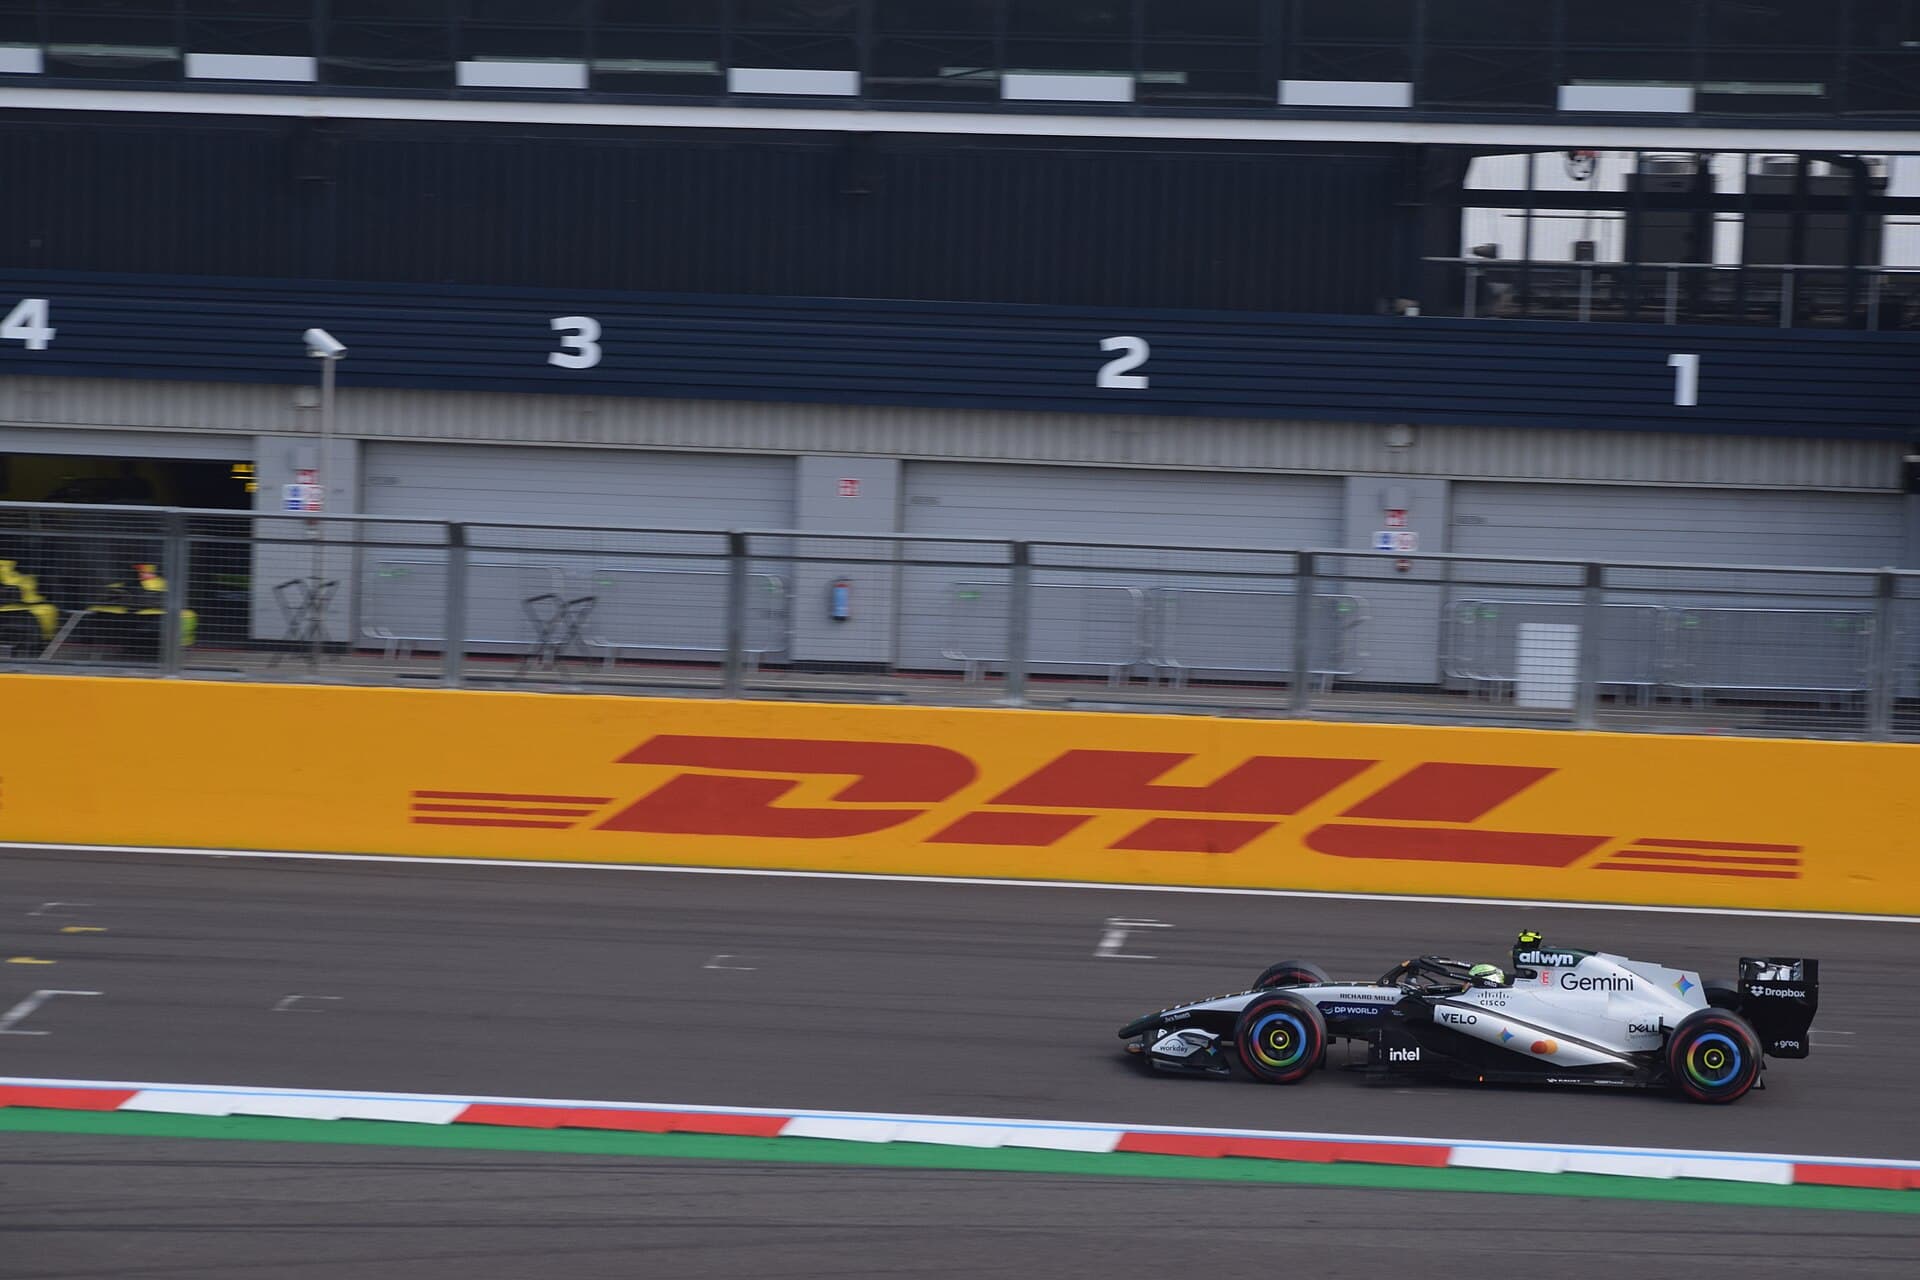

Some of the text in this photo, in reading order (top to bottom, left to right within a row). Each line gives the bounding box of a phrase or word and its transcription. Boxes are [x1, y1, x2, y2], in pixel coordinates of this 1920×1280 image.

[0, 298, 57, 350] 4
[547, 315, 602, 369] 3
[1096, 335, 1150, 389] 2
[1667, 353, 1700, 407] 1
[593, 735, 1614, 868] DHL
[1519, 950, 1574, 967] allwyn
[1560, 972, 1634, 991] Gemini
[1765, 987, 1806, 998] Dropbox
[1480, 999, 1506, 1007] CISCO
[1347, 1007, 1378, 1015] WORLD
[1441, 1012, 1478, 1025] VELO
[1628, 1023, 1659, 1033] DELL
[1160, 1044, 1188, 1053] workday
[1780, 1040, 1800, 1049] groq
[1389, 1047, 1420, 1061] intel
